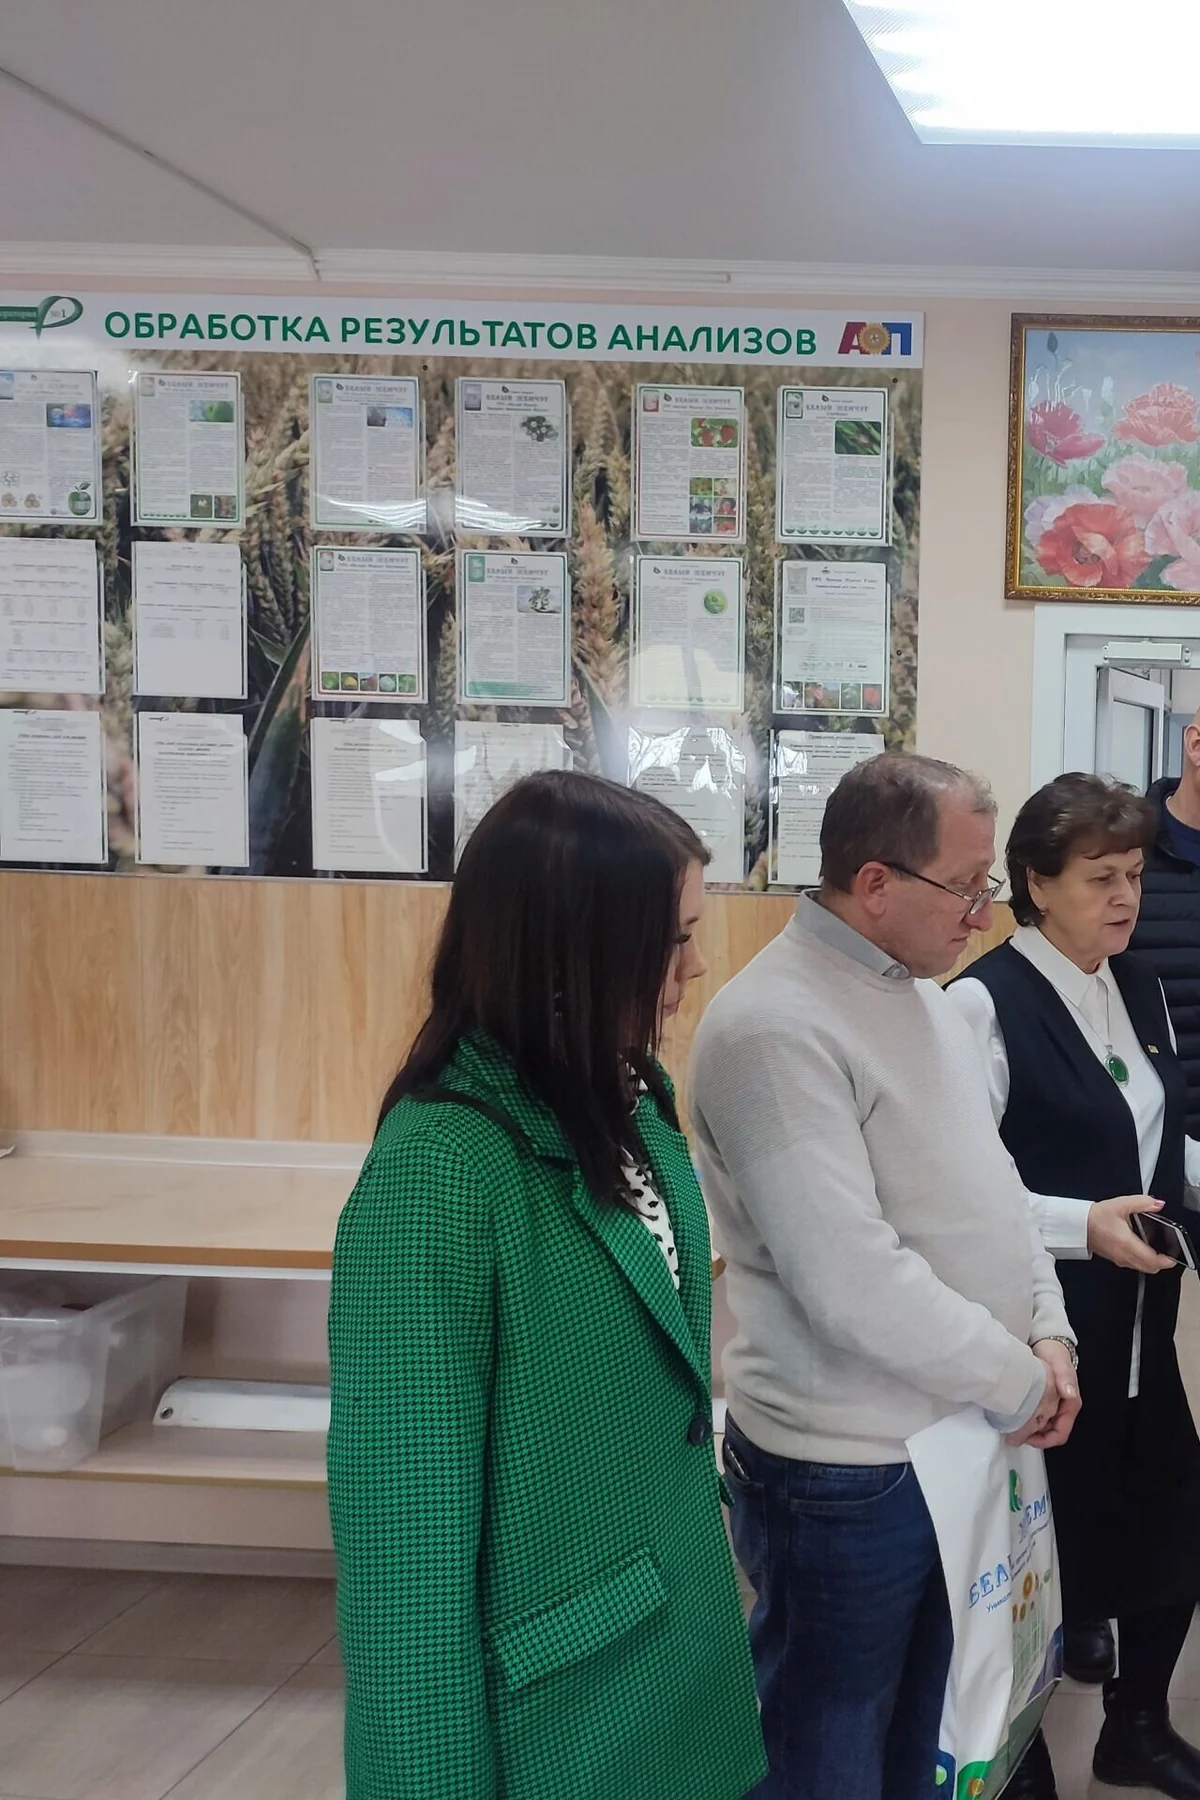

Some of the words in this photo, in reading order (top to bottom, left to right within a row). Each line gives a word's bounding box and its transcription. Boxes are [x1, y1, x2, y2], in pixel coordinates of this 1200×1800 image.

[104, 311, 331, 343] ОБРАБОТКА
[340, 317, 598, 350] РЕЗУЛЬТАТОВ
[607, 323, 818, 356] АНАЛИЗОВ
